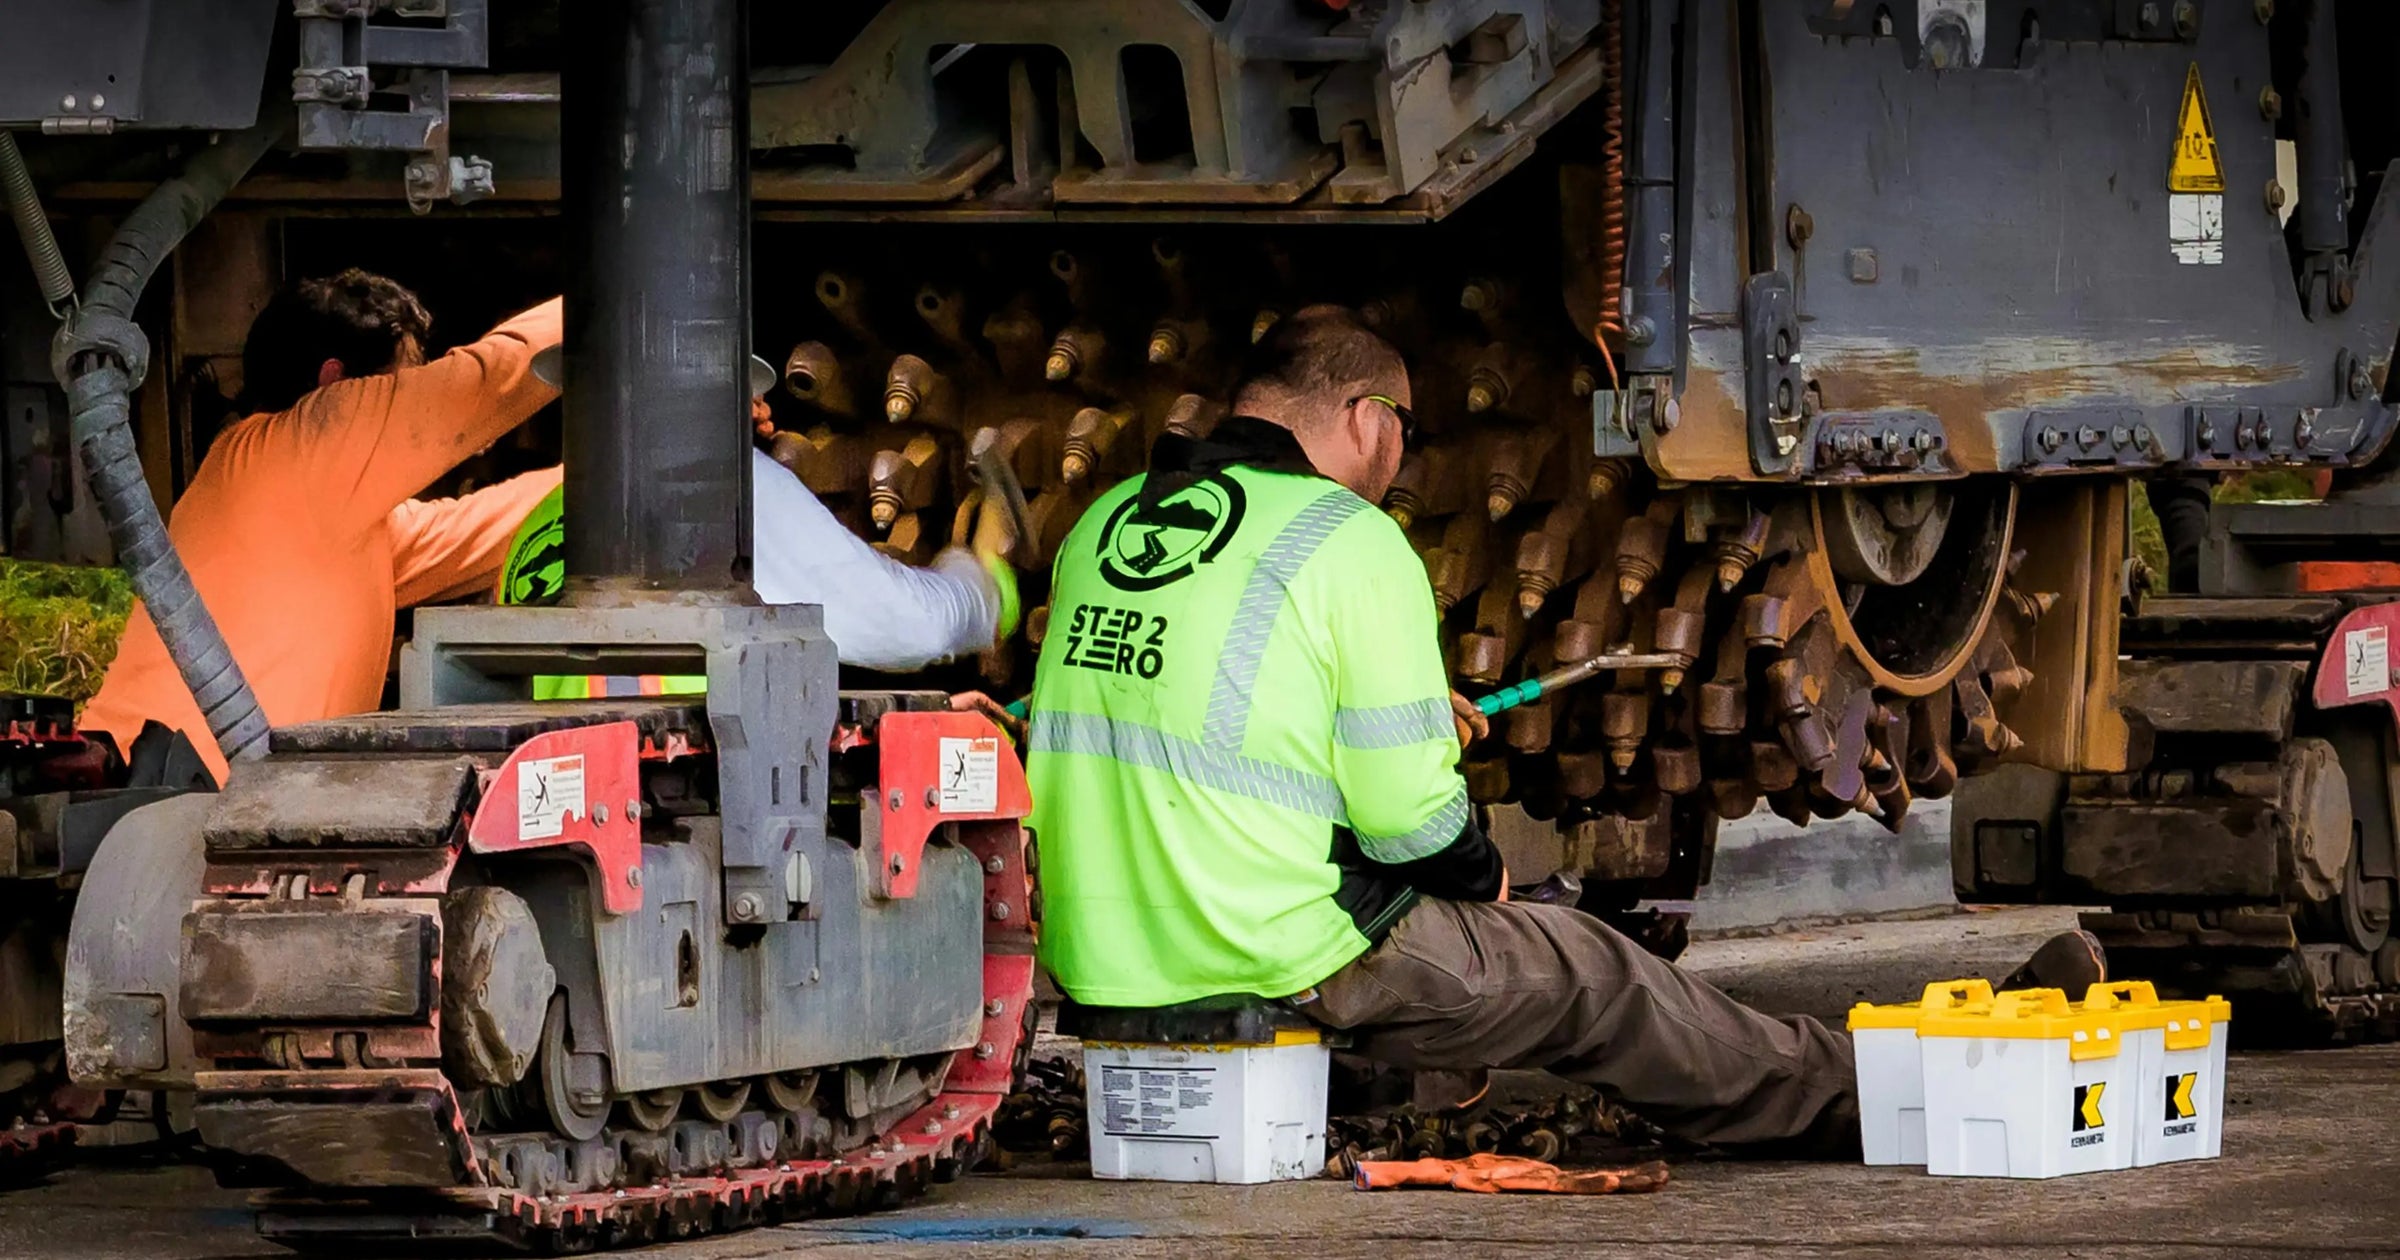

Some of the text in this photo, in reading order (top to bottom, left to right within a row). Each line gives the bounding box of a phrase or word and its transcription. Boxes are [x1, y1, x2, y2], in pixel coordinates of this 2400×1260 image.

[1070, 604, 1168, 646] STEP 2
[1062, 635, 1164, 680] ZERO
